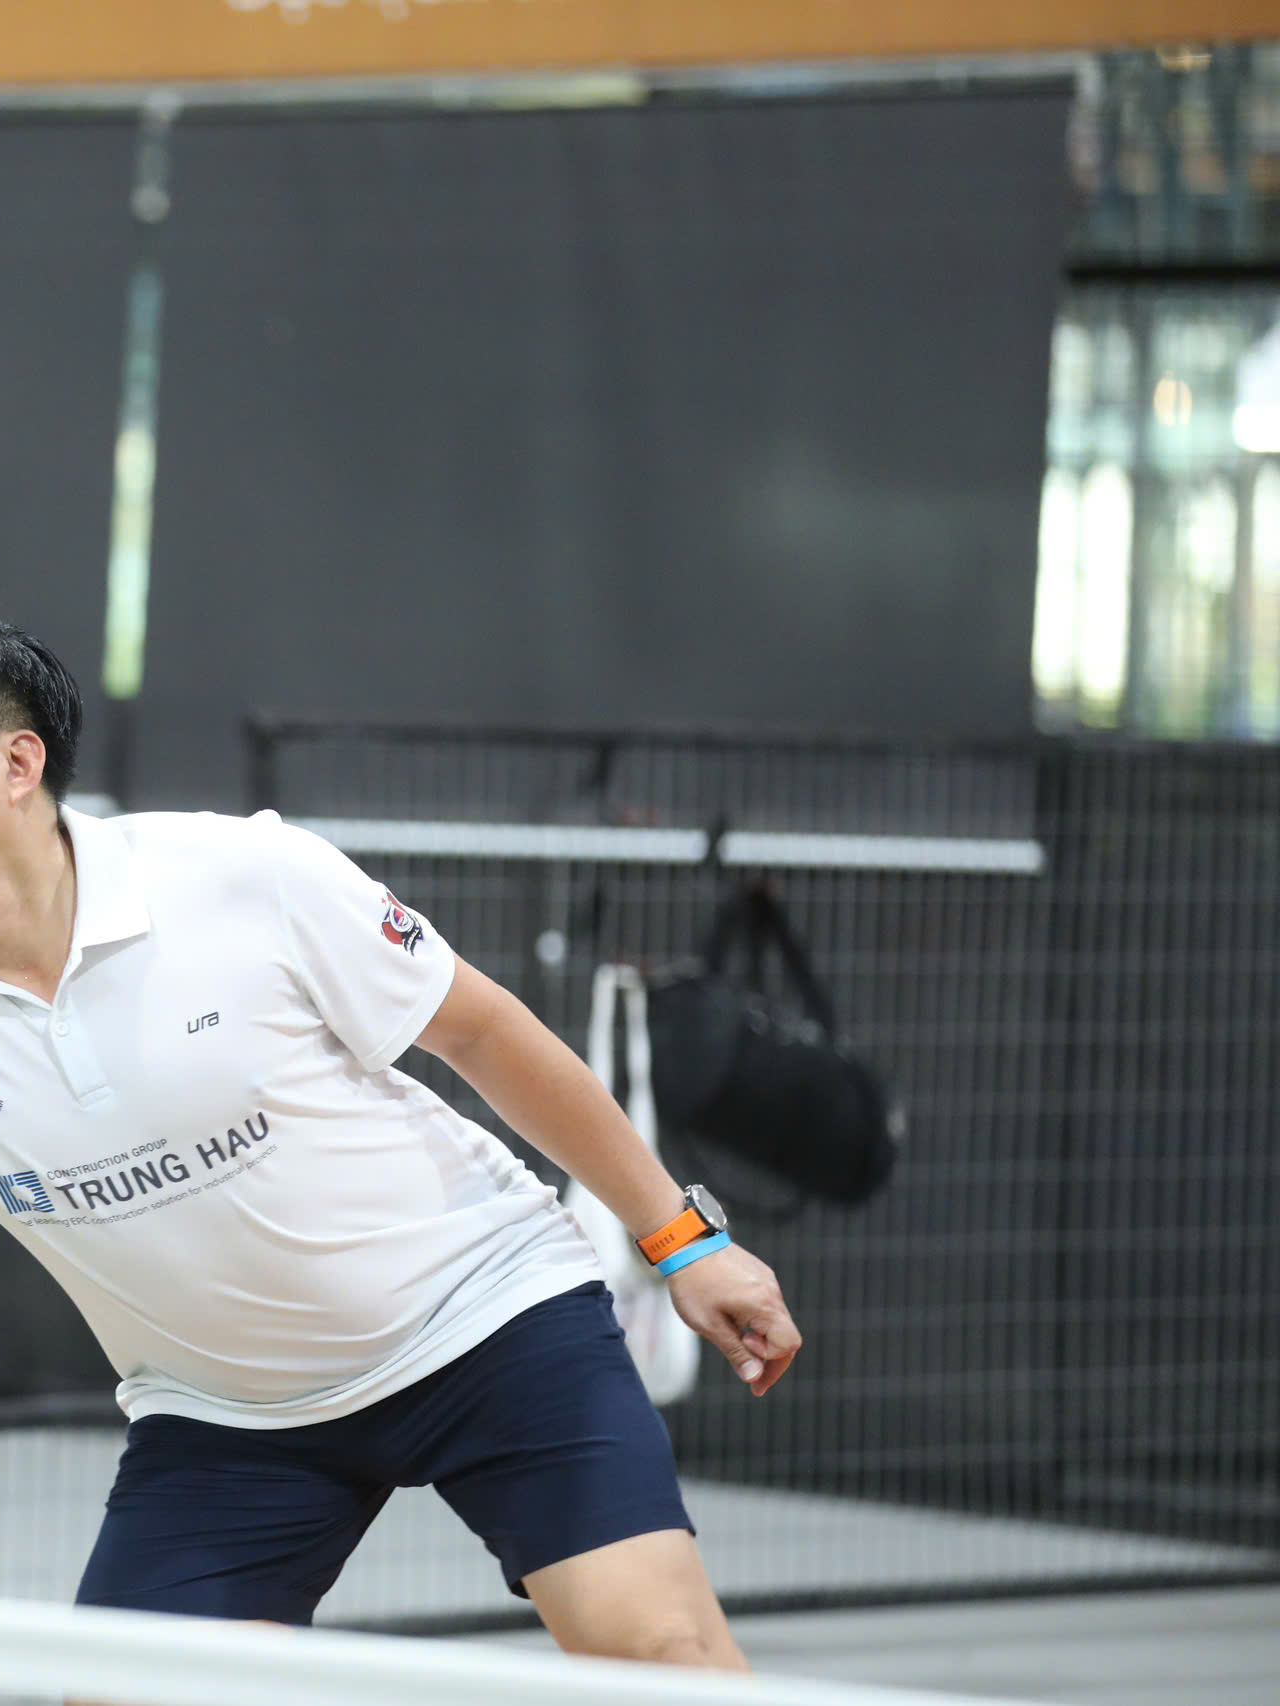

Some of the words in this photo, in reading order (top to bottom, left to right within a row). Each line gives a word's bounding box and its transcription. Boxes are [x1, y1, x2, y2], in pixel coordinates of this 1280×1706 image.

[46, 1151, 130, 1181] CONSTRUCTION
[131, 1138, 168, 1158] GROUP
[54, 1153, 191, 1210] TRUNG
[195, 1111, 269, 1170] HAU
[34, 1215, 70, 1228] leading
[70, 1215, 91, 1226] EPC
[91, 1206, 150, 1225] construction
[150, 1192, 188, 1210] solution
[188, 1185, 202, 1197] for
[204, 1164, 245, 1191] industrial
